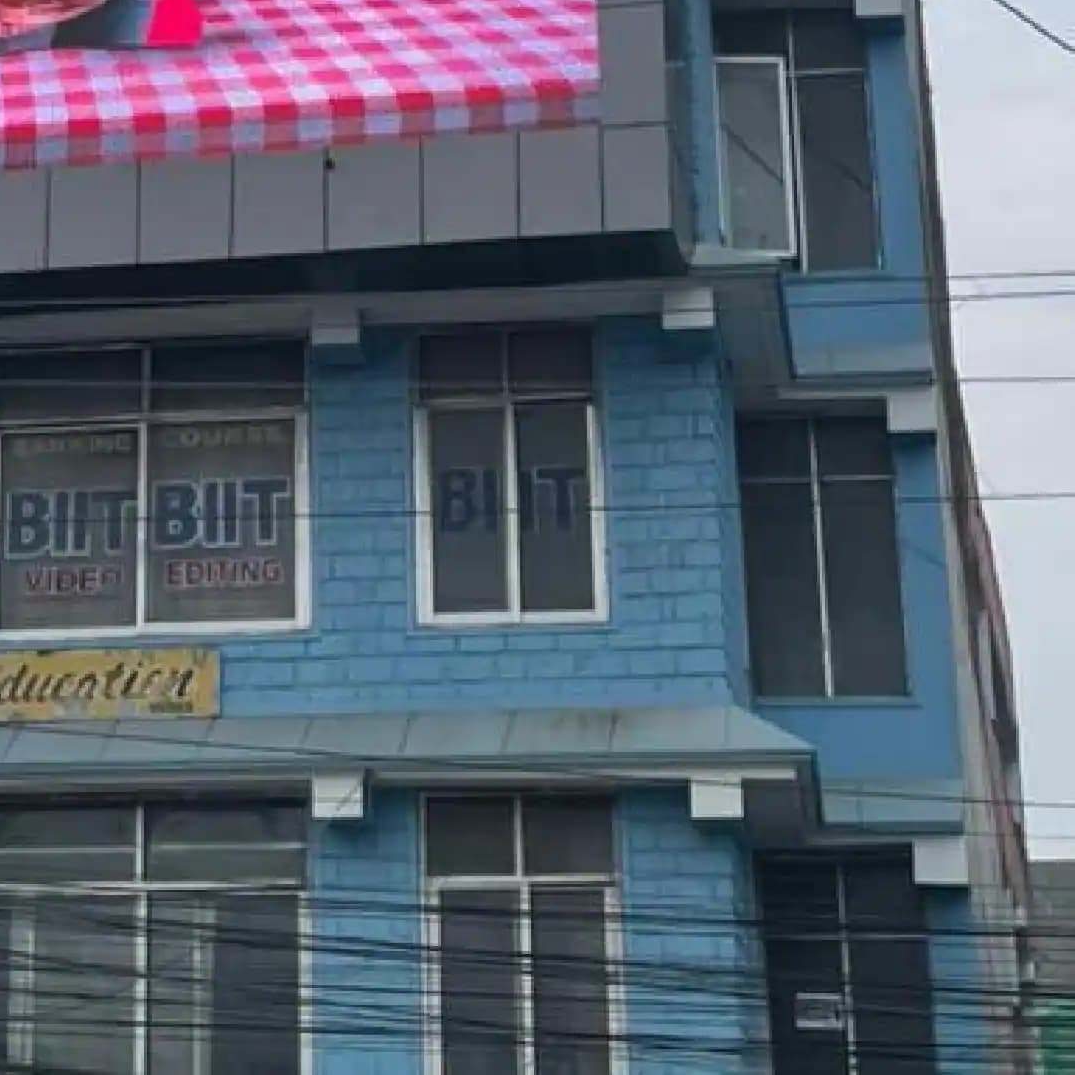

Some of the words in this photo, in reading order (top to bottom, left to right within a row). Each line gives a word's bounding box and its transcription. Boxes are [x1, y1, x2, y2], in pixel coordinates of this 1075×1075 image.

[3, 487, 138, 561] BIIT
[151, 476, 290, 549] BIIT
[166, 555, 285, 591] EDITING
